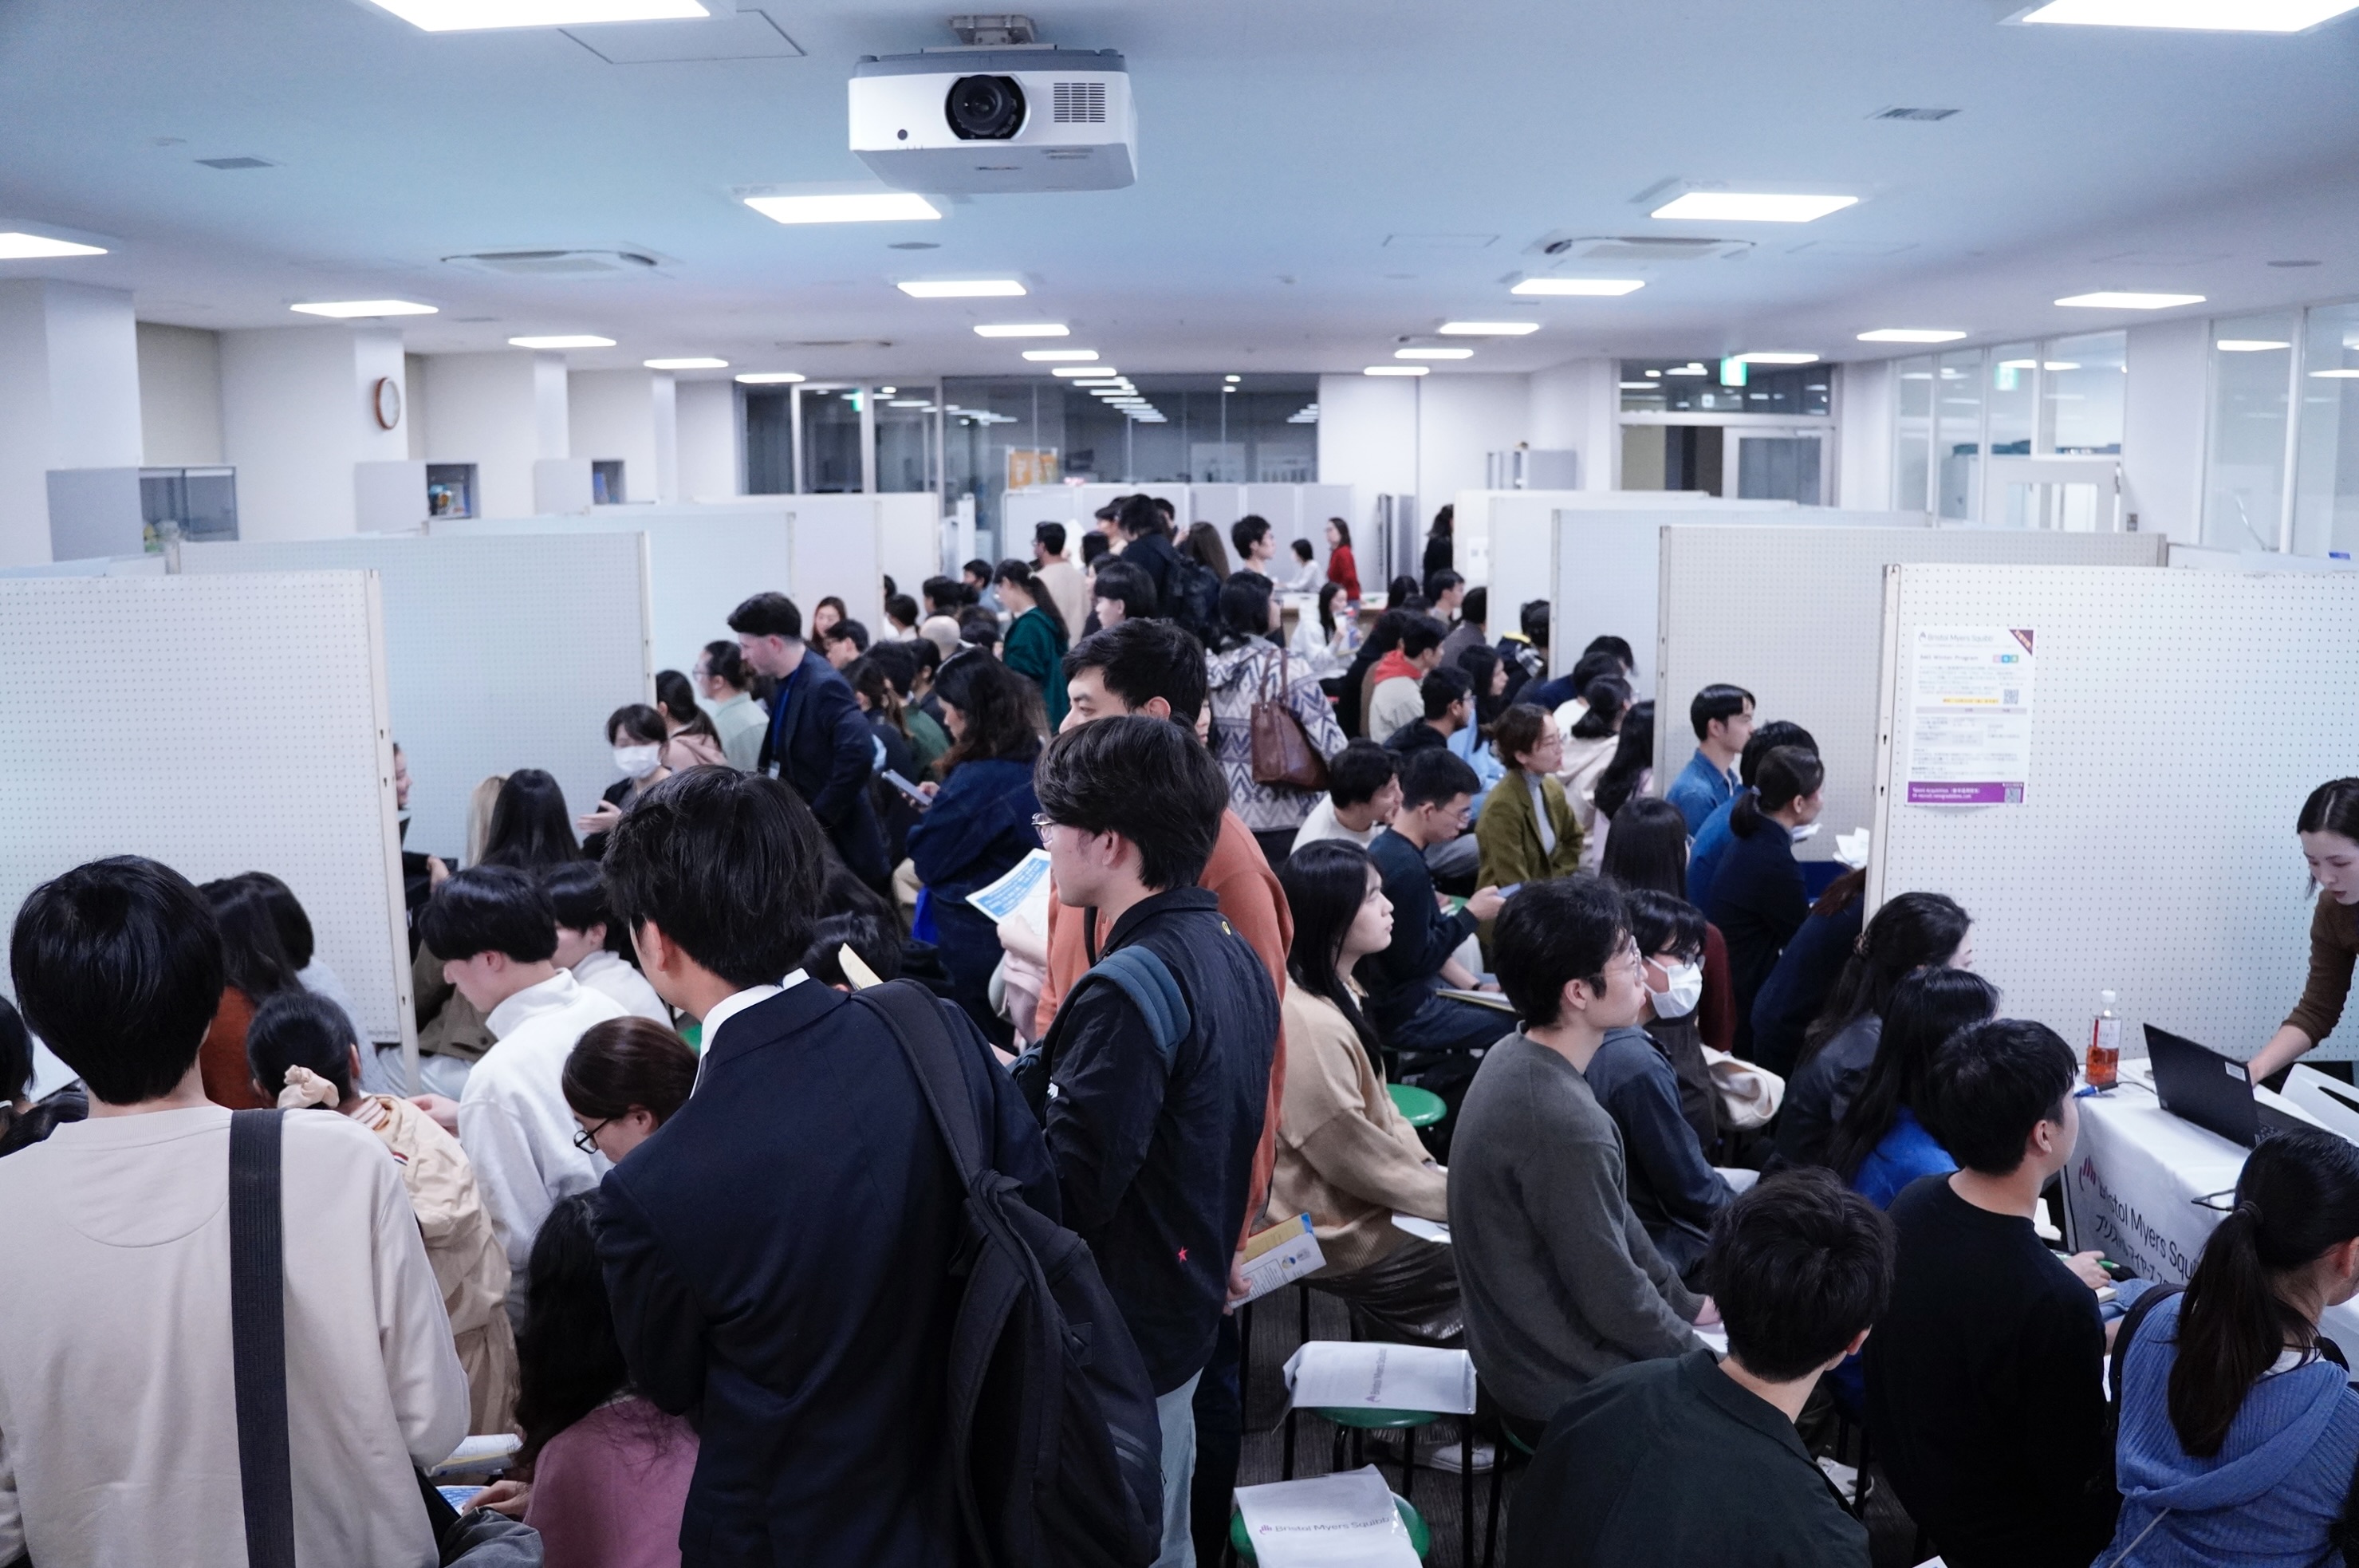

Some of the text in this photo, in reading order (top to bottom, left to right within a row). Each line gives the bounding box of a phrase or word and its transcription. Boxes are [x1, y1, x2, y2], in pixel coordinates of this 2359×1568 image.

[1950, 633, 1971, 643] Myers
[2131, 1208, 2166, 1259] Myers
[2169, 1240, 2198, 1282] Squi
[1350, 1517, 1390, 1528] Squibb
